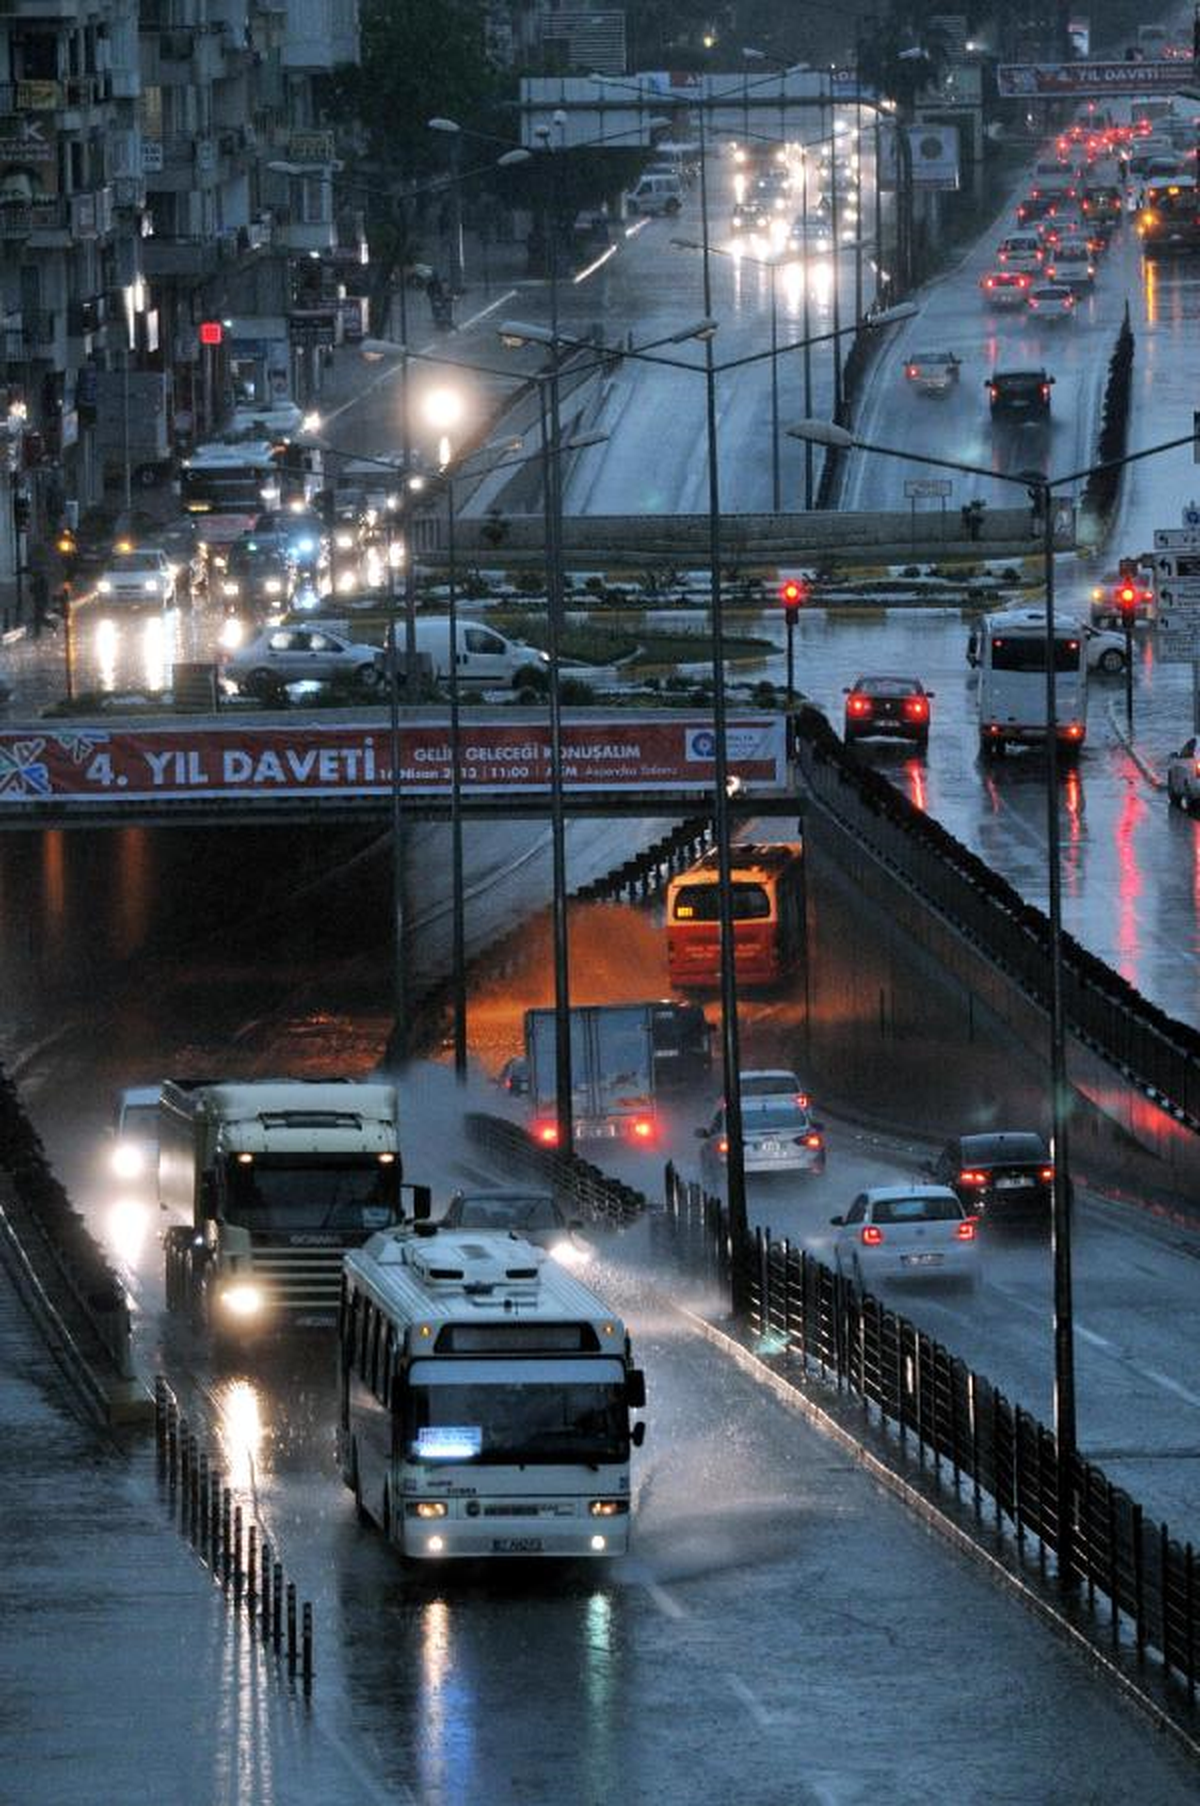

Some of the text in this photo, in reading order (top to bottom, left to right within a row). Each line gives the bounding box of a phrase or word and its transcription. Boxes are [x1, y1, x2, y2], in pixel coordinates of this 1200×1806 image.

[85, 737, 375, 785] 4. YIL DAVETİ
